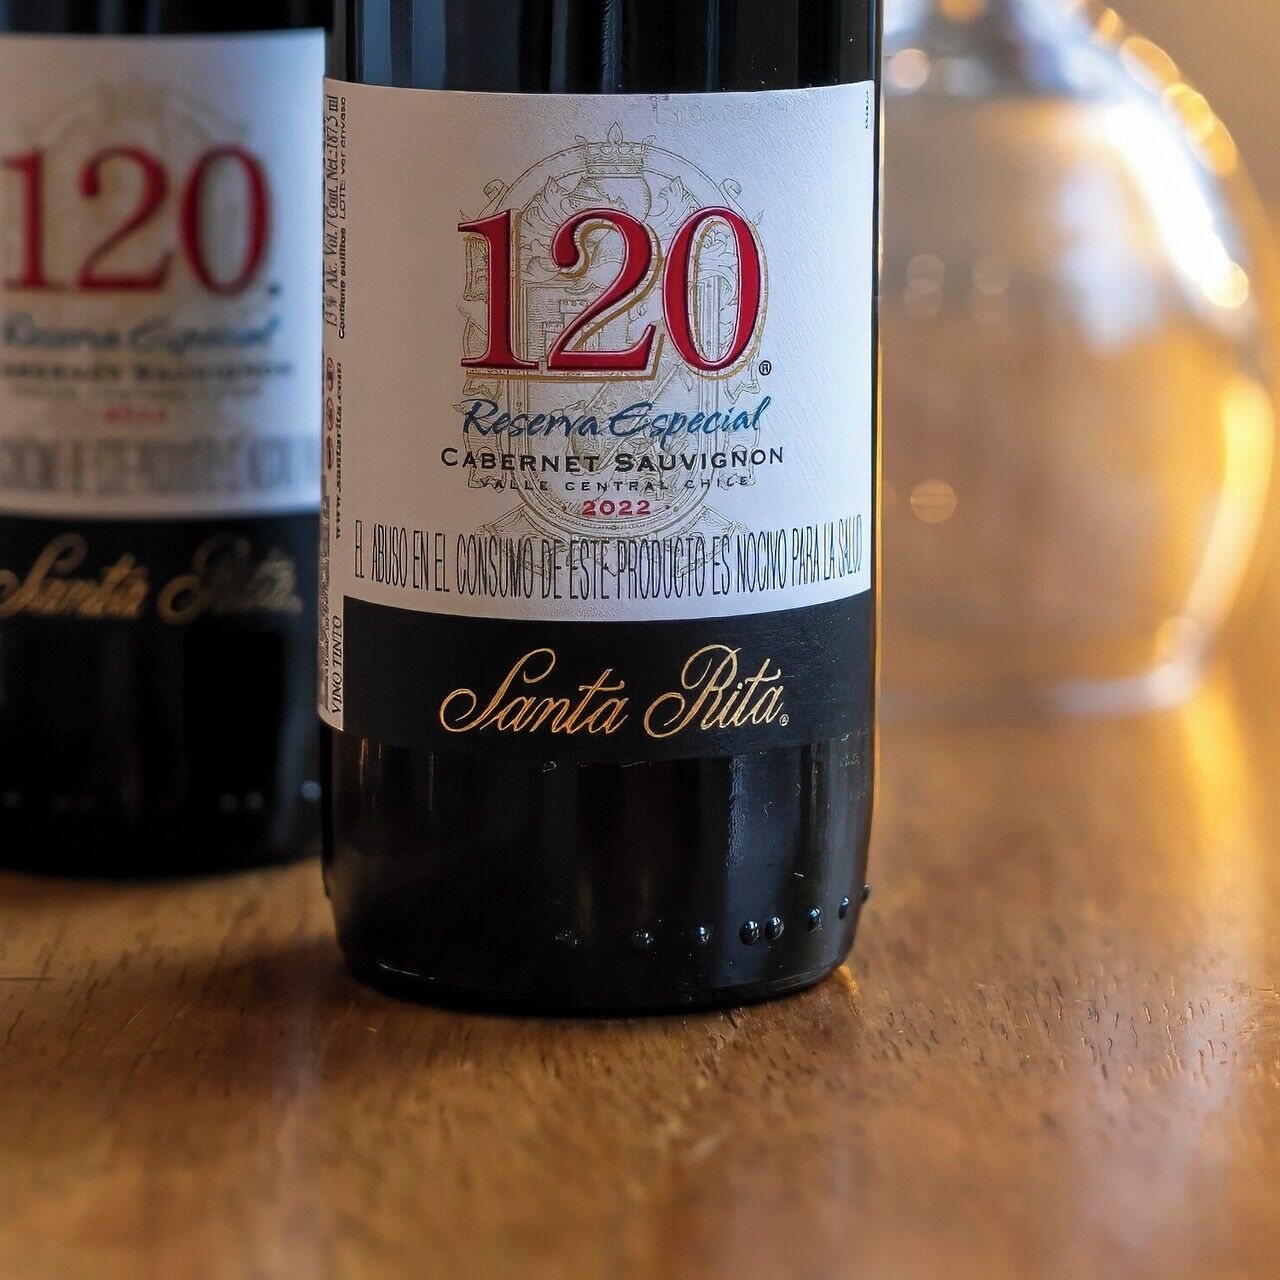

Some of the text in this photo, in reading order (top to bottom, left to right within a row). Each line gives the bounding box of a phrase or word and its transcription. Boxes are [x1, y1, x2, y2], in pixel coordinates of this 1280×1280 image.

[0, 145, 271, 298] 120
[458, 206, 764, 375] 120
[440, 446, 784, 472] CABERNET SAUVIGNON
[461, 396, 772, 450] Reserva Especial
[480, 476, 549, 491] VALLE
[684, 474, 750, 489] CHILE
[581, 499, 652, 517] 2022
[354, 514, 863, 600] EL ABUSO EN EL CONSUMO DE ESTE PRODUCTO ES NOCIVO PARA LA SALUD
[331, 615, 342, 714] VINO TINTO
[439, 644, 786, 738] Santa Rita
